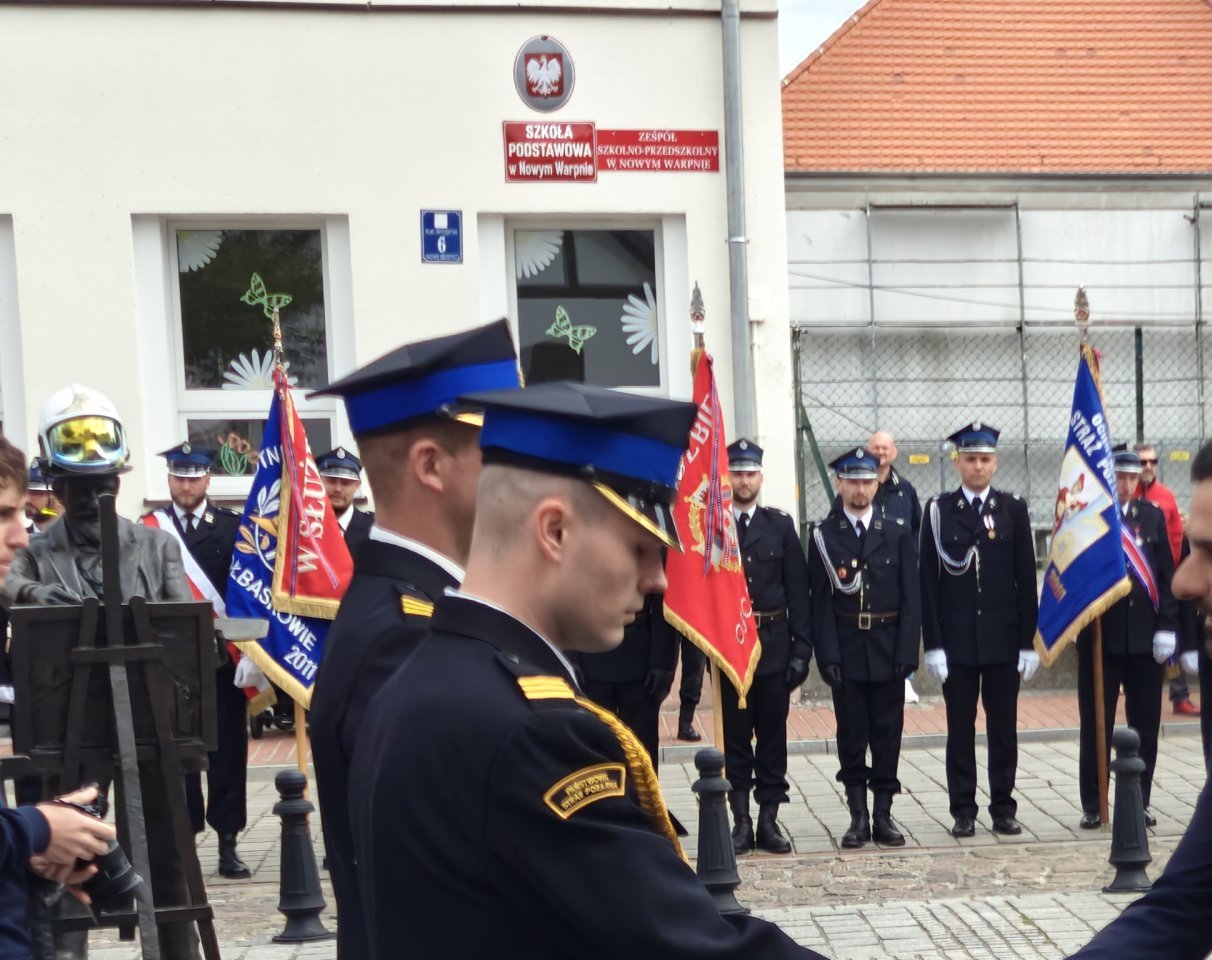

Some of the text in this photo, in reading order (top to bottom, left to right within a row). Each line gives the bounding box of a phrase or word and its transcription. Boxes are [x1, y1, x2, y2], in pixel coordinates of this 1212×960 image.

[525, 124, 574, 139] SZKOŁA
[508, 142, 592, 157] PODSTAWOWA
[597, 144, 718, 156] SZKOLNO-PRZEDSZKOLNY
[508, 161, 594, 179] w Nowym Warpnie
[606, 158, 711, 170] W NOWYM WARPNIE
[437, 235, 446, 254] 6
[283, 645, 319, 681] 2011
